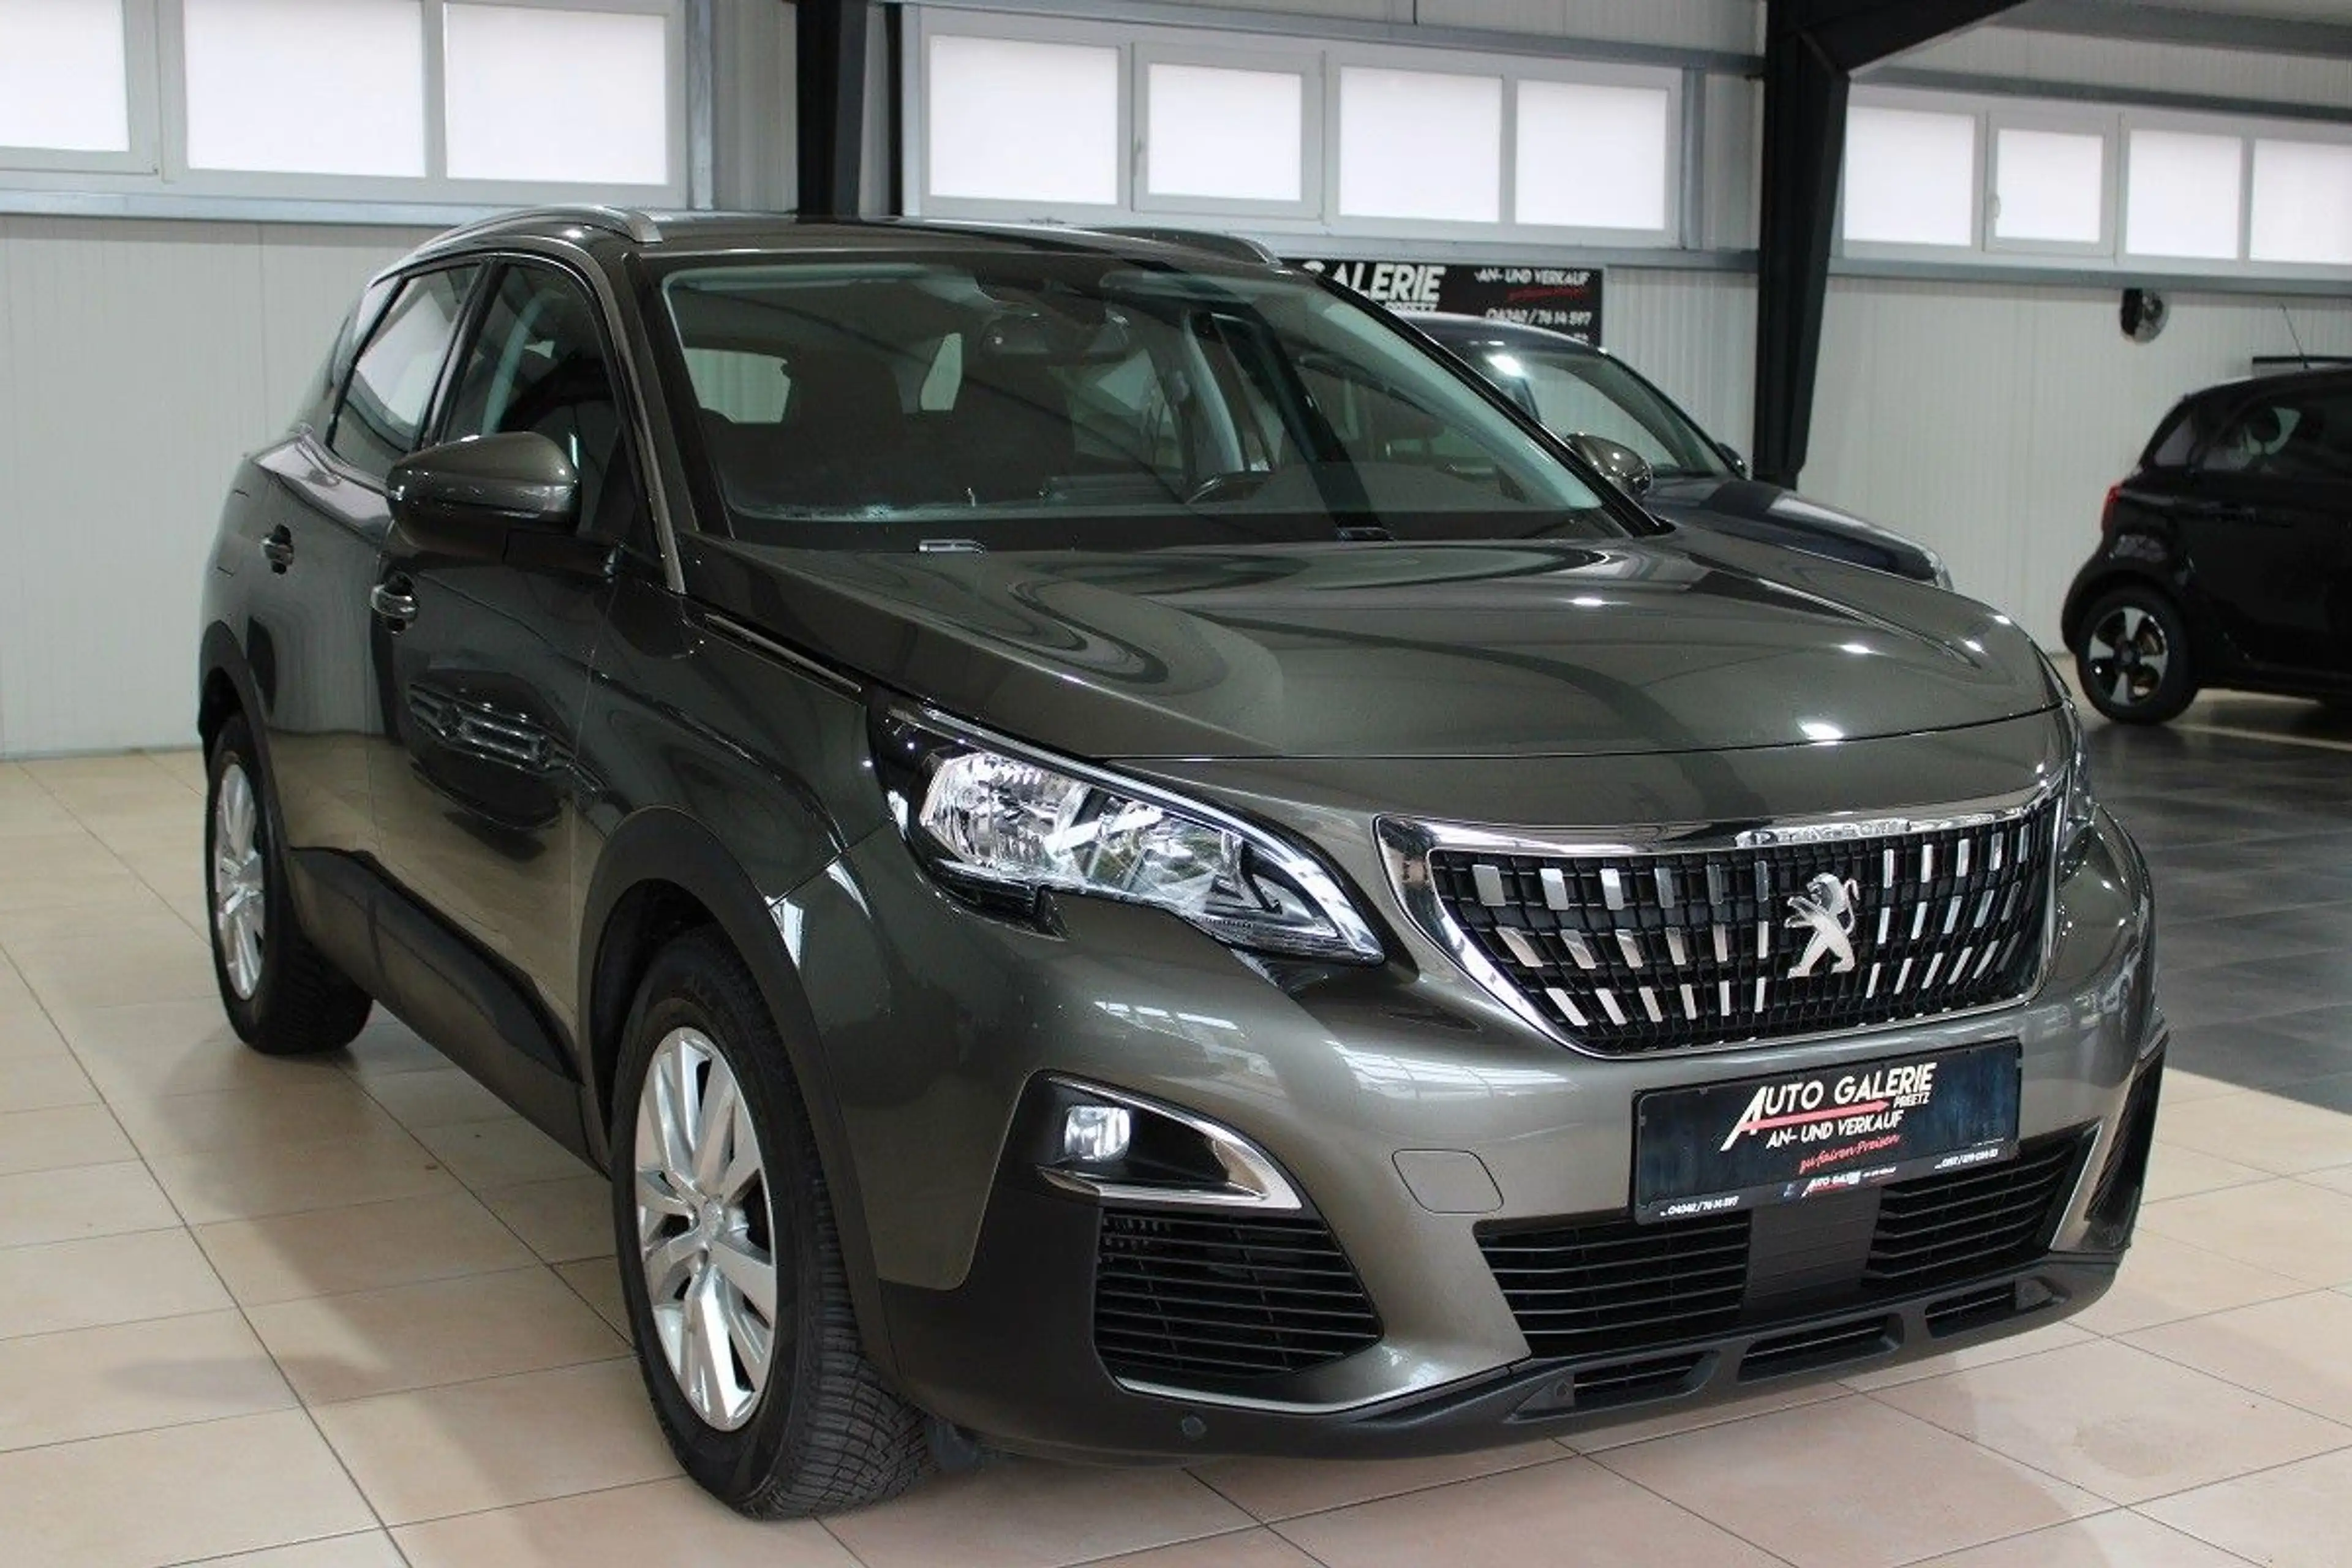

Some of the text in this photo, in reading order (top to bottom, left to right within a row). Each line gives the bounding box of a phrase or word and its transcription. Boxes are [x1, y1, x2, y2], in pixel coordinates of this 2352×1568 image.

[1504, 268, 1531, 284] UND
[1534, 269, 1590, 286] VERKAUF
[1720, 1062, 1937, 1152] AUTO GALERIE
[1766, 1110, 1904, 1149] AN- UND VERKAUF
